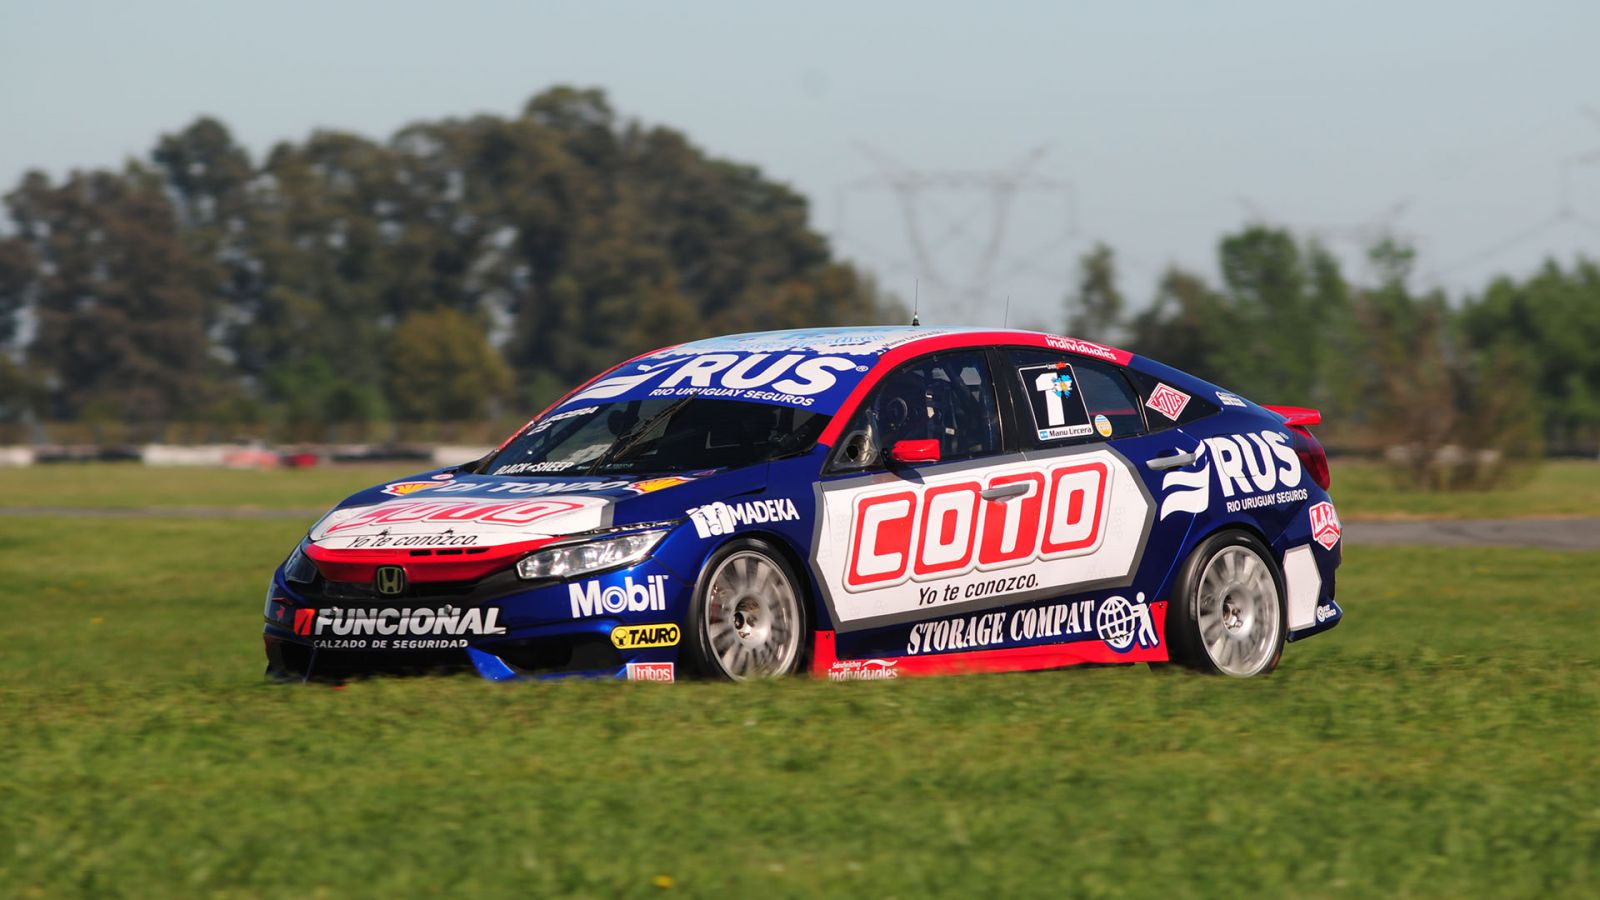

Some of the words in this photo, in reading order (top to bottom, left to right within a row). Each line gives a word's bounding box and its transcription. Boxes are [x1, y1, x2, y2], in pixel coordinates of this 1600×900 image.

[1044, 336, 1117, 361] individuales
[657, 353, 859, 395] RUS
[648, 388, 674, 397] RIO
[675, 387, 746, 399] URUGUAY
[745, 389, 815, 407] SEGUROS
[1035, 372, 1065, 427] 1
[1049, 429, 1068, 438] Manu
[532, 461, 575, 473] SHEEP
[1203, 430, 1301, 497] RUS
[727, 498, 800, 526] MADEKA
[1226, 501, 1241, 513] RIO
[1242, 497, 1276, 509] URUGUAY
[1276, 488, 1308, 504] SEGUROS
[847, 462, 1108, 586] COTO
[347, 536, 370, 548] Yo
[392, 535, 478, 546] conozco.
[568, 575, 667, 618] Mobil
[919, 587, 937, 606] Yo
[943, 584, 958, 601] te
[965, 573, 1039, 599] conozco.
[314, 607, 507, 635] FUNCIONAL
[907, 620, 1004, 655] STORAGE
[1010, 600, 1094, 641] COMPAT
[314, 639, 367, 649] CALZADO
[372, 639, 387, 649] DE
[392, 639, 468, 649] SEGURIDAD
[628, 626, 678, 645] TAURO
[636, 666, 671, 682] tribos
[827, 664, 899, 681] individuales
